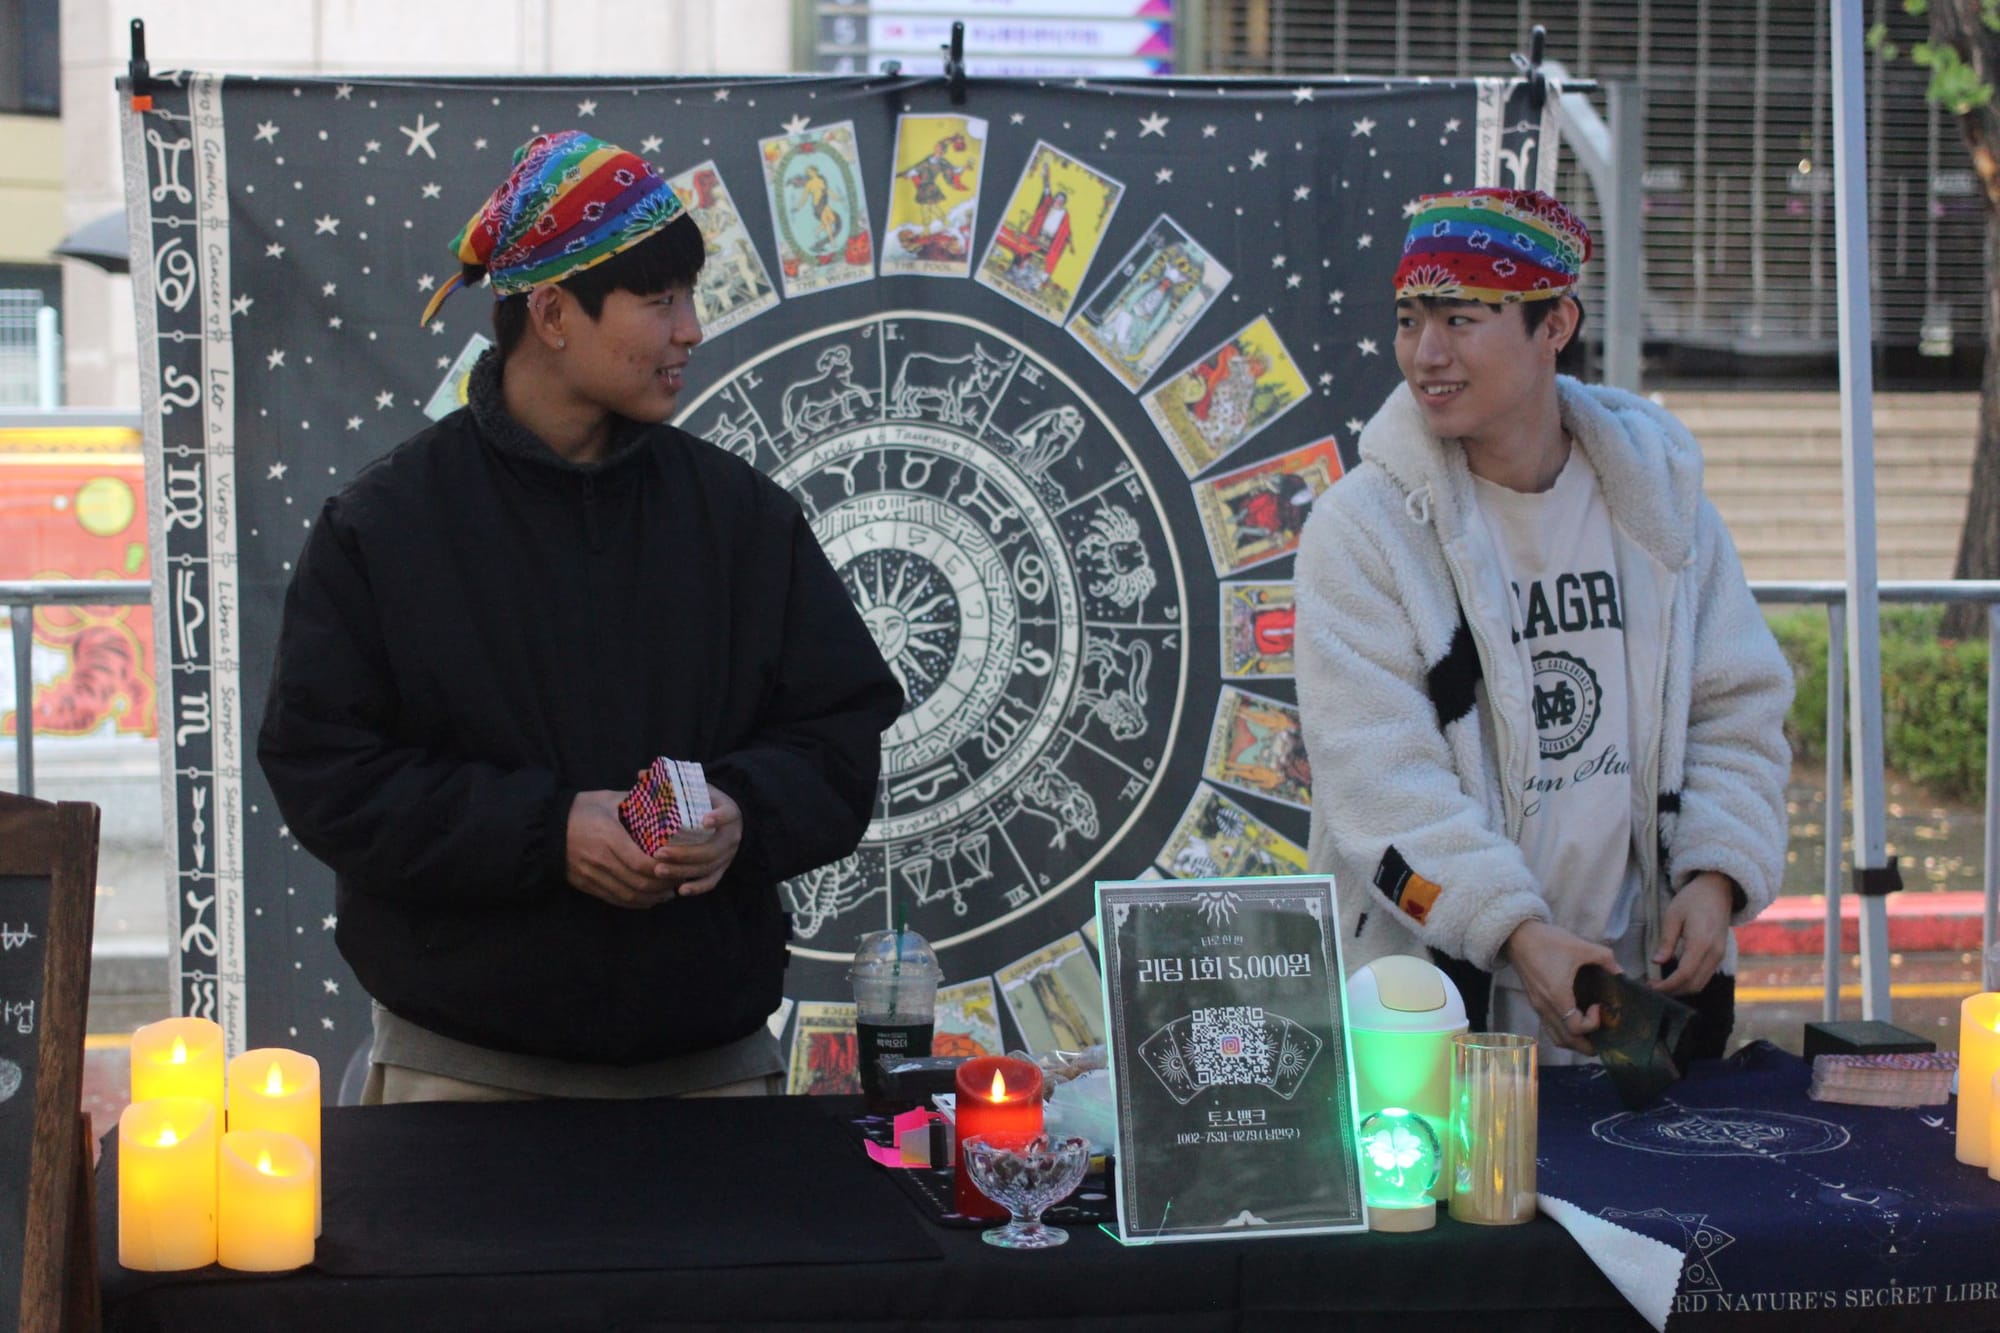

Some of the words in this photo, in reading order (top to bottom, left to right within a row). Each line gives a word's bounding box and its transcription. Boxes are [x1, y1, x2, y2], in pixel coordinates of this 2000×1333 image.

[202, 138, 223, 202] Gemini
[207, 242, 225, 307] Cancer
[208, 368, 230, 411] Leo
[806, 436, 859, 466] Aries
[893, 427, 949, 448] Taurus
[212, 473, 232, 531] Virgo
[1043, 536, 1073, 600] Cancer
[218, 581, 234, 645] Libra
[1511, 570, 1624, 645] AGR
[1057, 649, 1076, 685] Leo
[218, 686, 236, 751] Scorpio
[904, 802, 961, 831] Libra
[222, 889, 240, 958] Capricorn
[1138, 958, 1183, 983] 리딩
[1189, 956, 1223, 981] 1회
[1229, 953, 1312, 981] 5,000원
[1208, 1109, 1267, 1127] 토스뱅크
[1677, 1294, 1707, 1312] RD
[1717, 1290, 1837, 1311] NATURE'S
[1845, 1286, 1937, 1307] SECRET
[1945, 1281, 2000, 1302] LIBR
